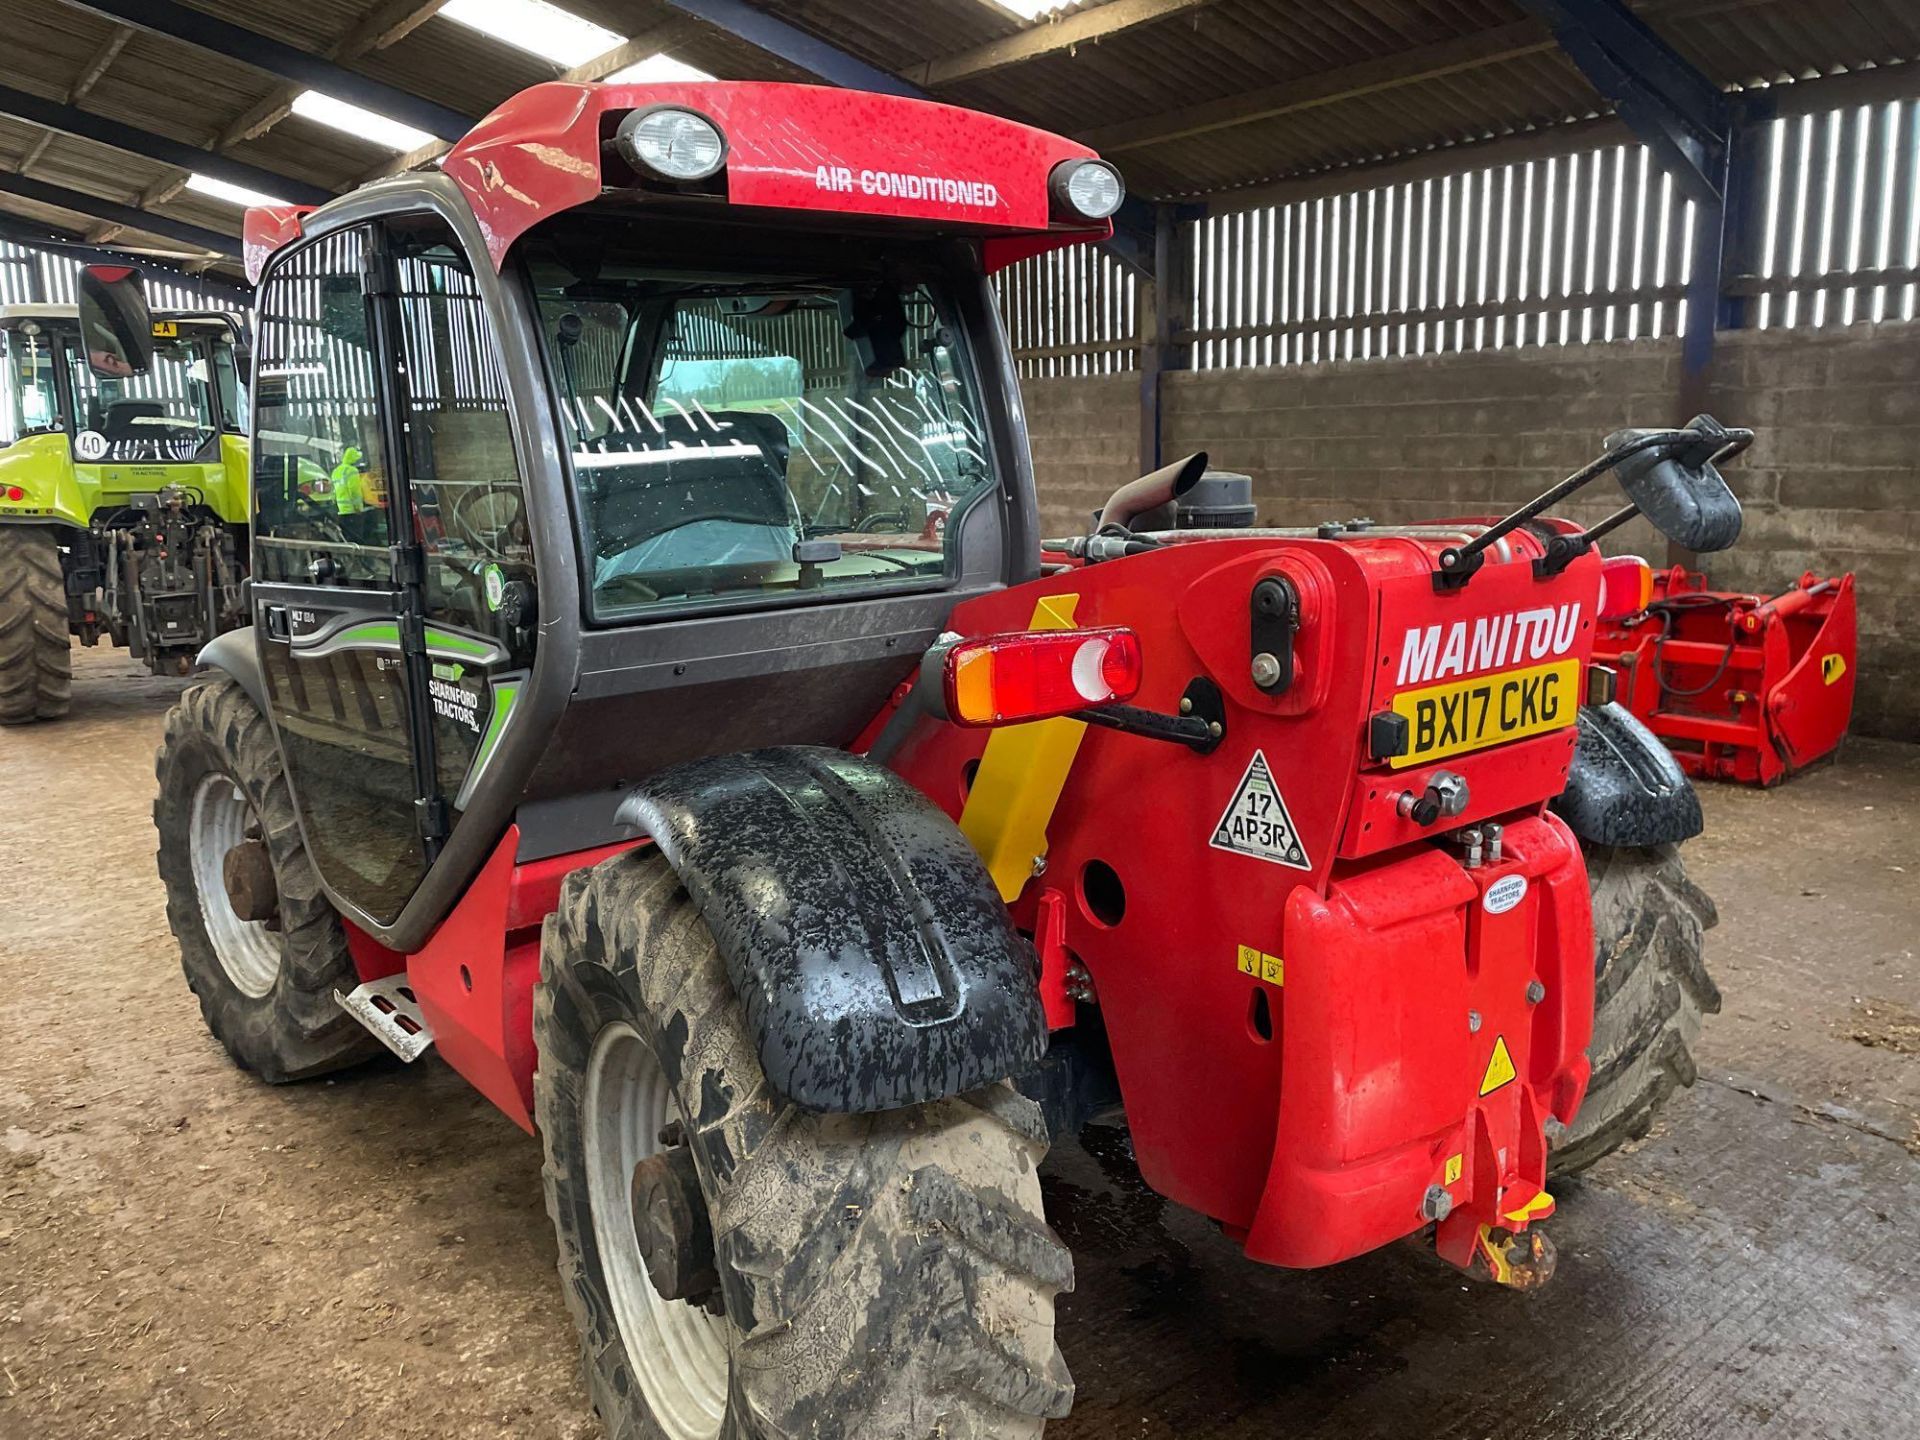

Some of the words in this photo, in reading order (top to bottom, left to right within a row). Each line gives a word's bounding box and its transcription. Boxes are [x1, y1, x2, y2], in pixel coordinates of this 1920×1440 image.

[815, 165, 853, 193] AIR
[860, 169, 998, 207] CONDITIONED
[82, 436, 101, 454] 40
[1395, 602, 1581, 687] MANITOU
[428, 680, 478, 710] SHARNFORD
[432, 698, 475, 726] TRACTORS
[1414, 685, 1491, 754] BX17
[1500, 672, 1559, 732] CKG
[1247, 791, 1272, 819] 17
[1232, 815, 1286, 850] AP3R
